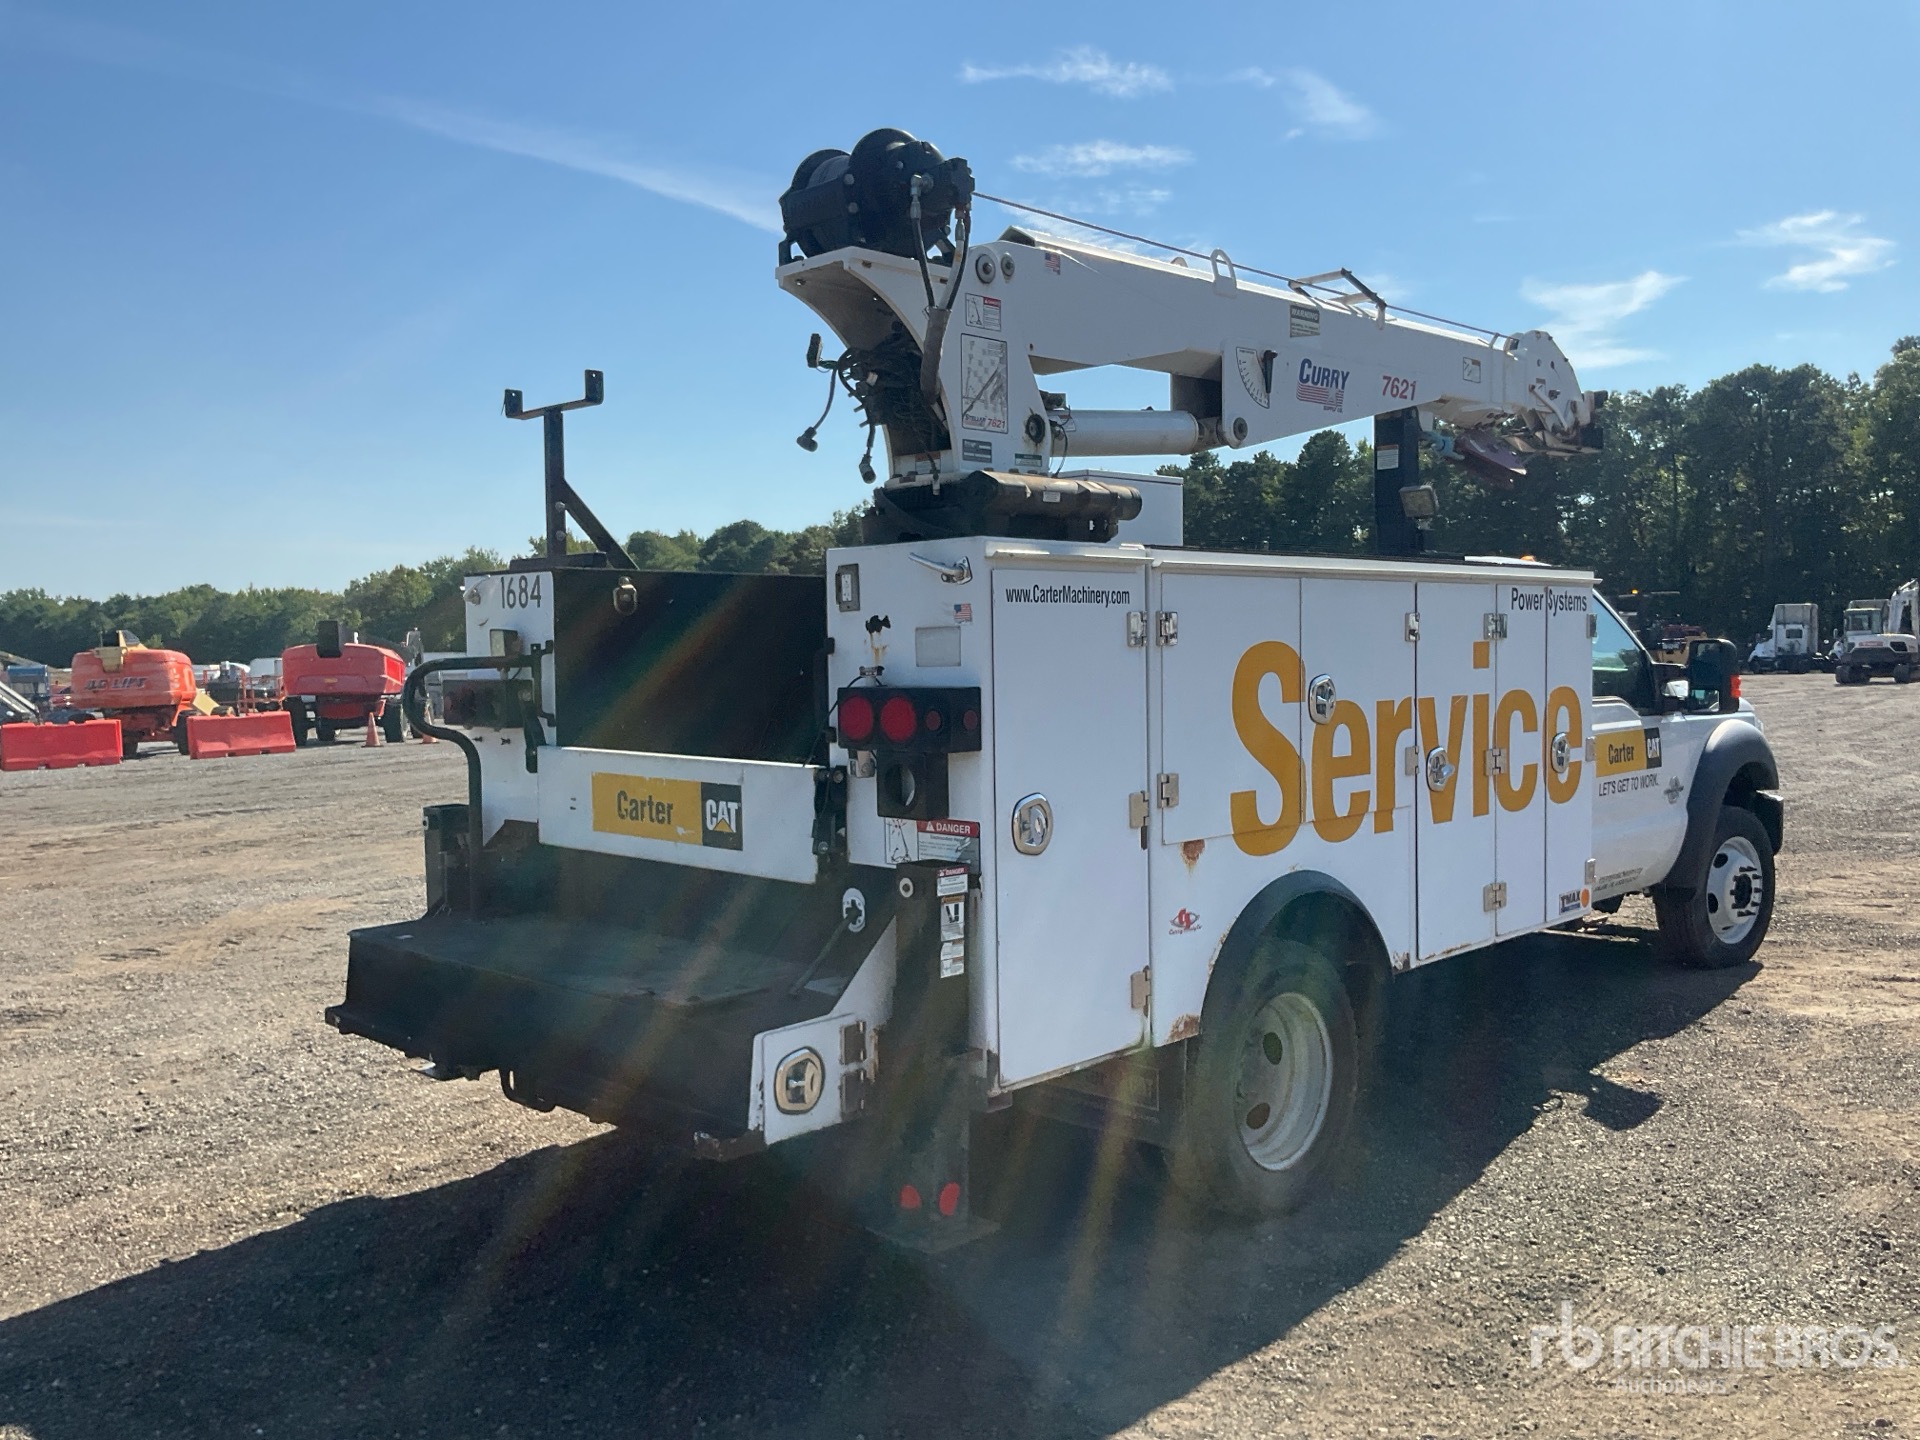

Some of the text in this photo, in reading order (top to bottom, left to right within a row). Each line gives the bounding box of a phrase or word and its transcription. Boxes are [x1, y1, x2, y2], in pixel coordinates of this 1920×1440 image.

[1292, 308, 1319, 321] WARNING
[1299, 357, 1350, 391] CURRY
[1382, 375, 1417, 401] 7621
[987, 418, 1006, 430] 7621
[501, 575, 542, 609] 1684
[1006, 584, 1131, 608] www.CarterMachinery.com
[1511, 587, 1588, 616] Power Systems
[112, 677, 148, 689] LIFT
[1230, 640, 1583, 856] Service
[1608, 744, 1635, 765] Carter
[1646, 736, 1660, 759] CAT
[1598, 780, 1616, 797] LET'S
[1617, 778, 1630, 792] GET
[1630, 777, 1639, 790] TO
[617, 790, 675, 825] Carter
[705, 799, 739, 833] CAT
[936, 822, 971, 835] DANGER
[945, 867, 965, 876] DANGER
